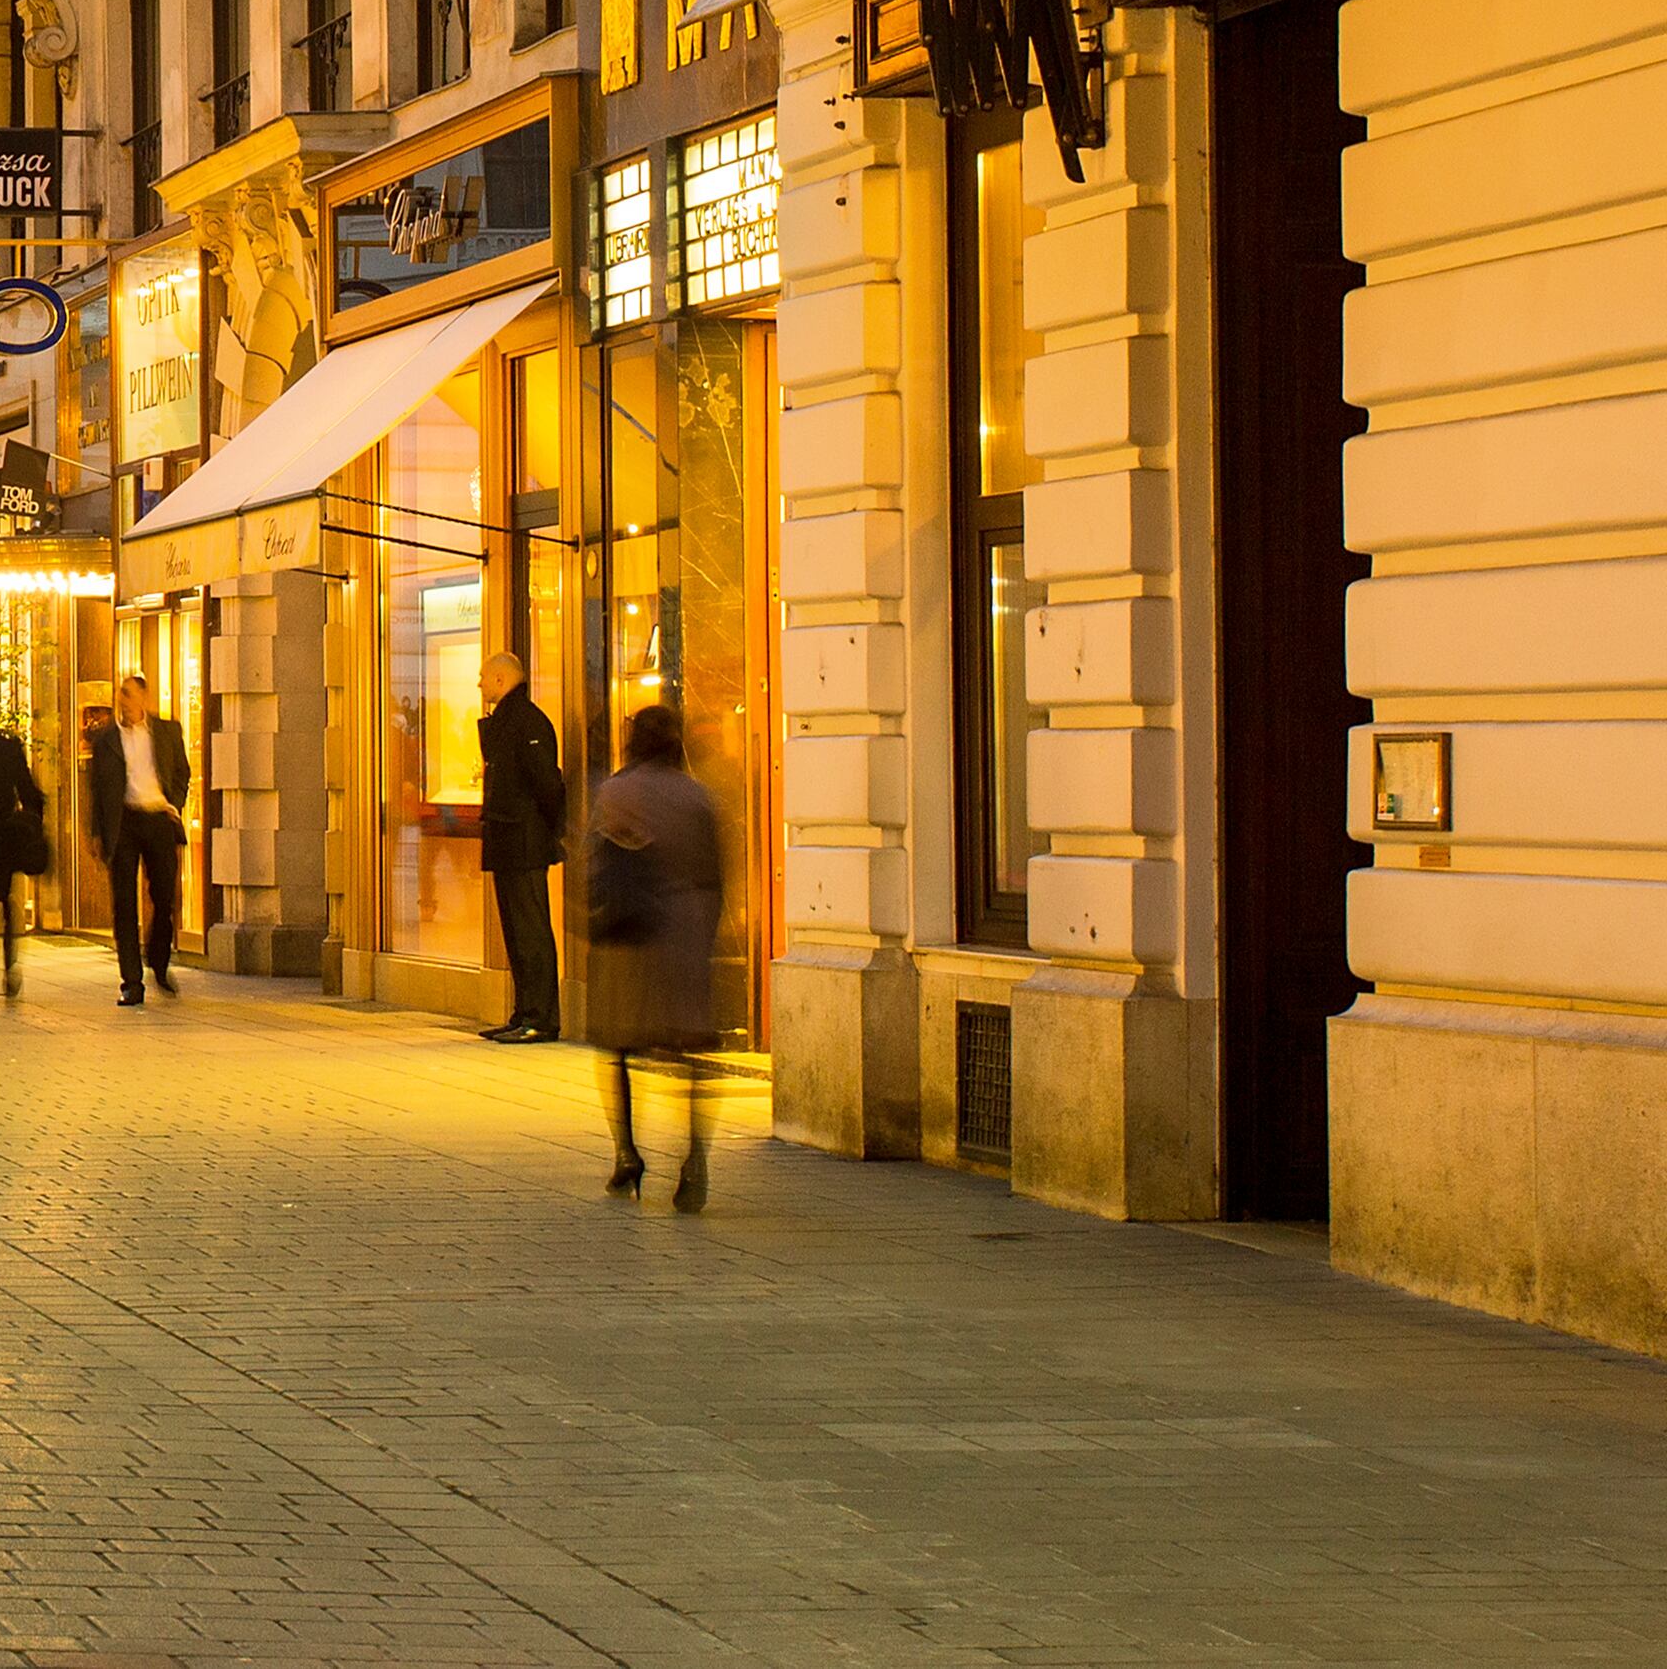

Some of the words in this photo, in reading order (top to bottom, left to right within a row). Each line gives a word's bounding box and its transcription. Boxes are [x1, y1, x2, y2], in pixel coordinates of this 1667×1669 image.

[136, 268, 181, 326] OPTIK
[129, 351, 194, 414] PILLWEIN
[0, 484, 33, 501] TOM
[0, 497, 40, 516] FORD
